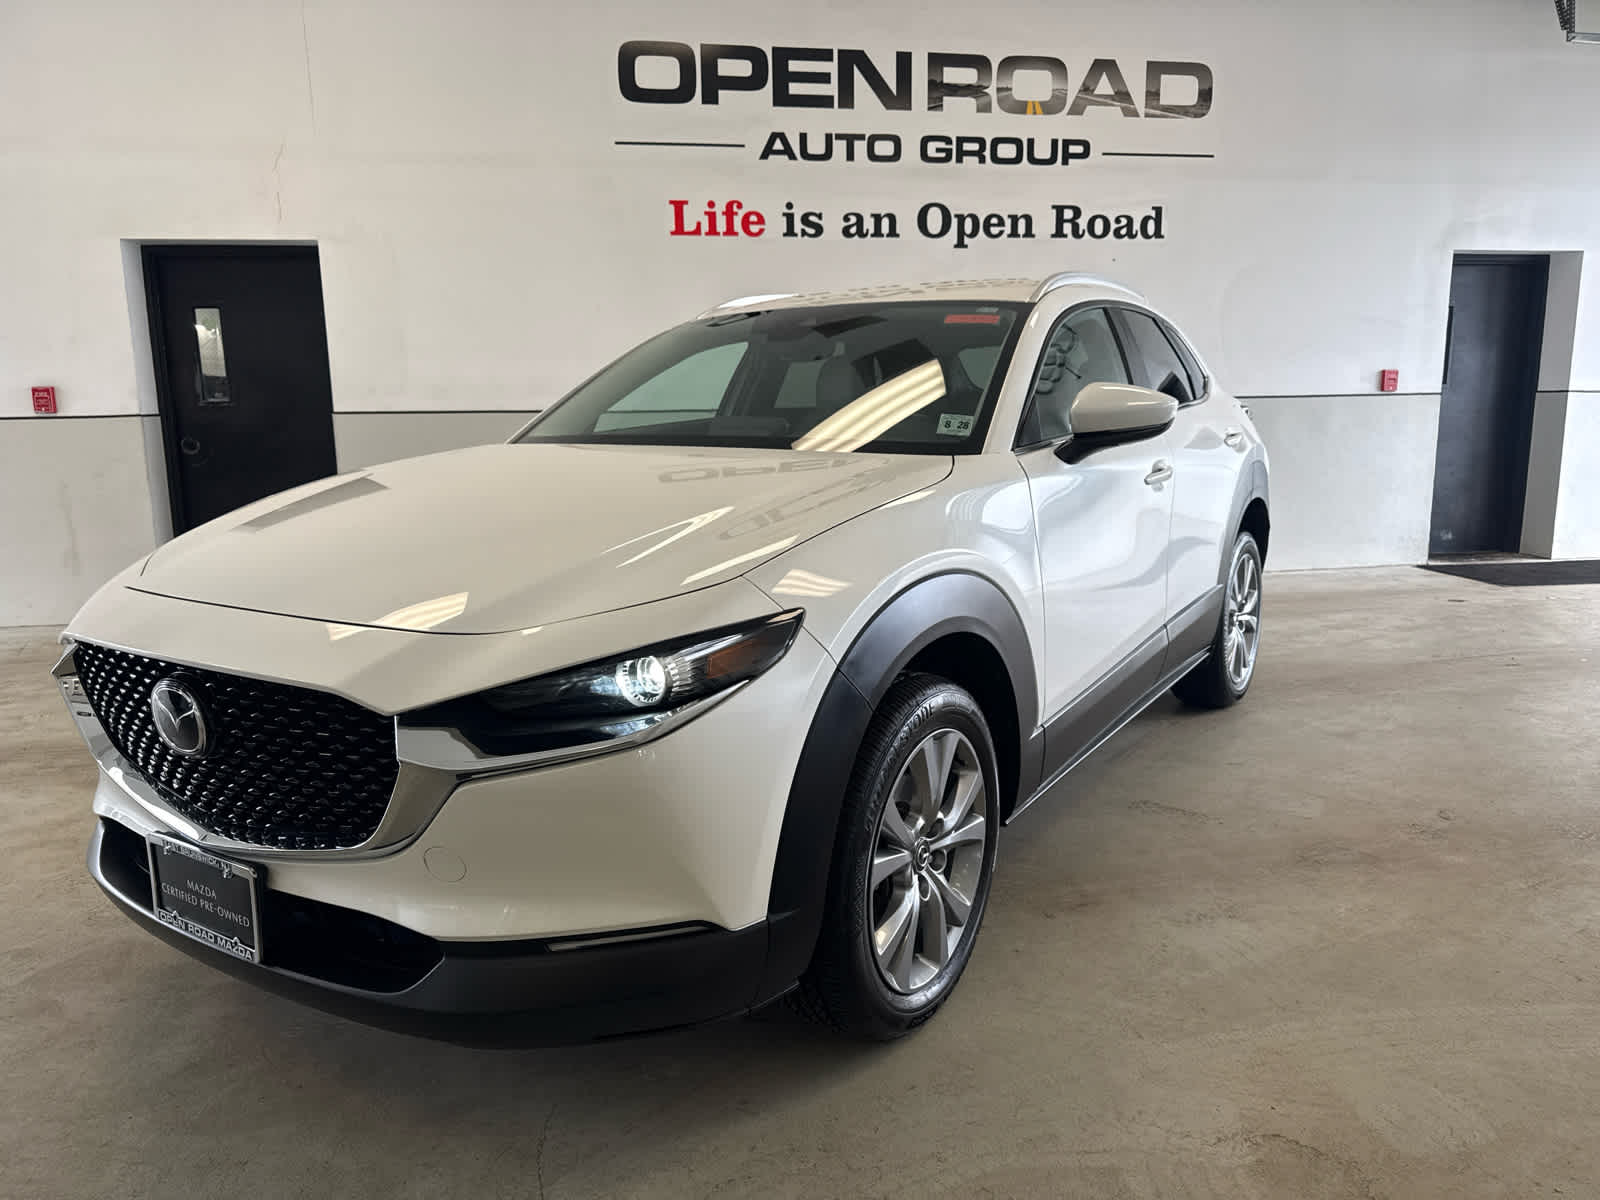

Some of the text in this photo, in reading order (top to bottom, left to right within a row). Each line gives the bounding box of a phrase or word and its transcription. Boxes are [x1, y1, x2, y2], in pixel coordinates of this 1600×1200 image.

[617, 39, 1214, 120] OPEN ROAD
[758, 130, 1092, 167] AUTO GROUP
[668, 199, 1166, 249] Life is an Open Road
[161, 882, 250, 928] CERTIFIED PRE-OWNED
[186, 879, 217, 900] MAZDA
[159, 911, 254, 961] OPEN ROAD MAZDA
